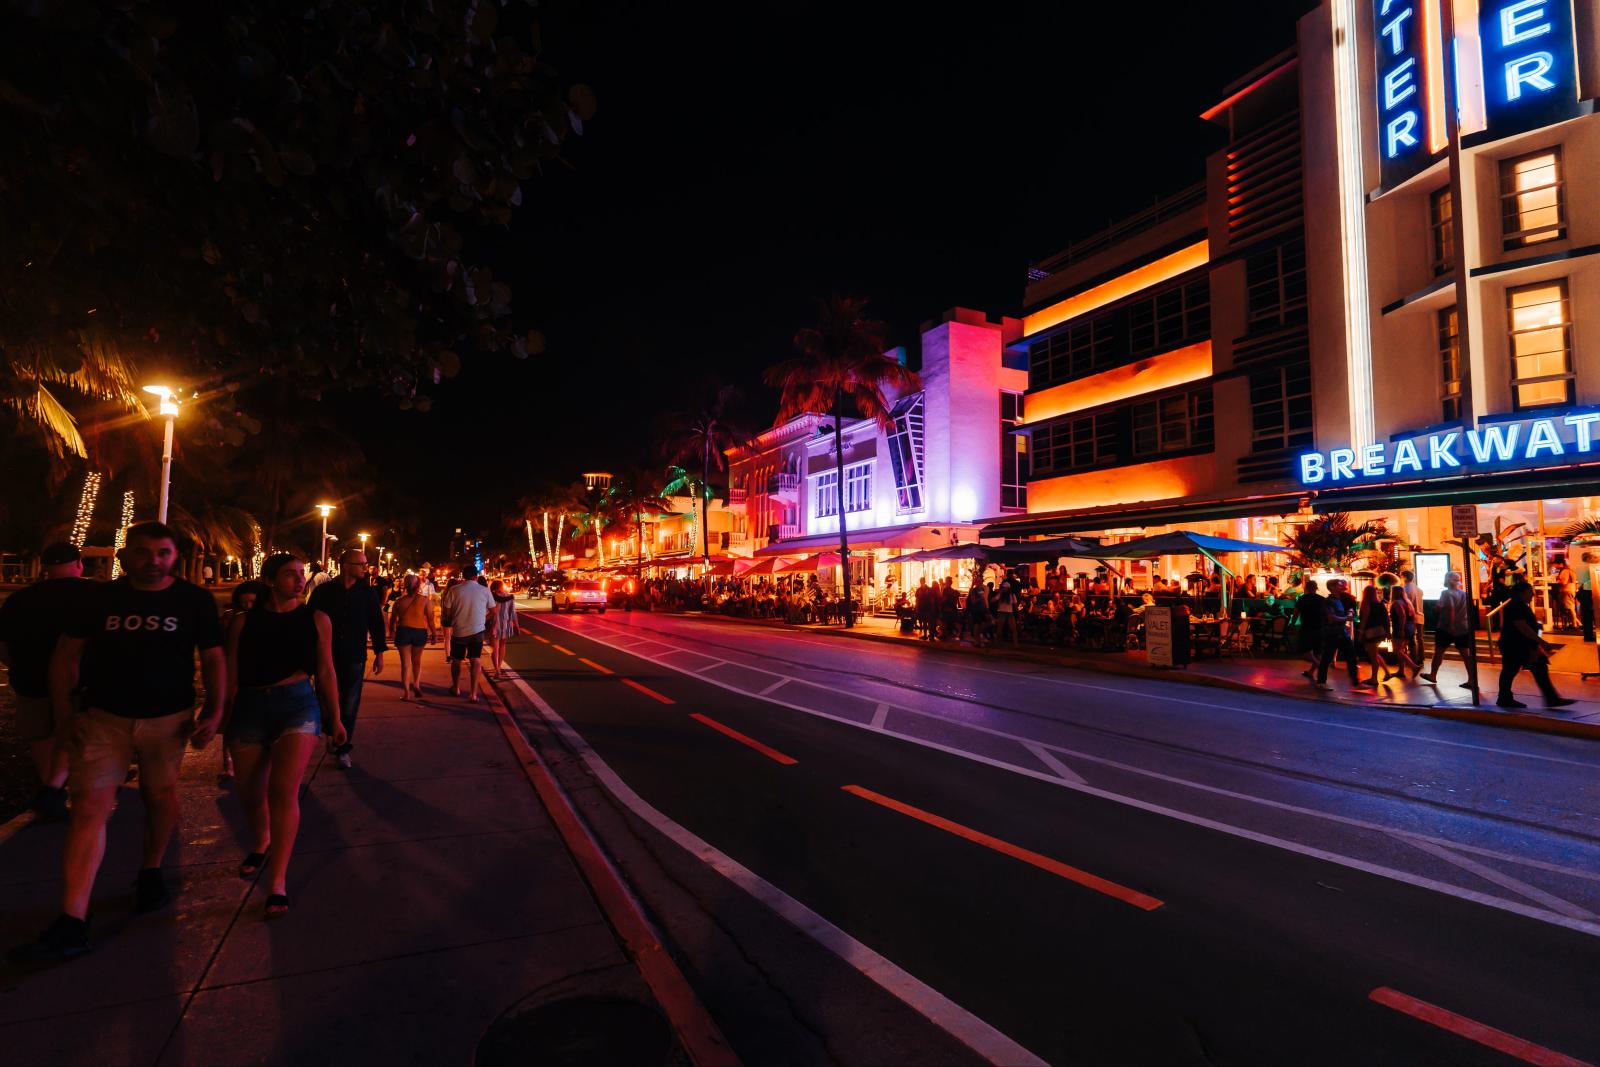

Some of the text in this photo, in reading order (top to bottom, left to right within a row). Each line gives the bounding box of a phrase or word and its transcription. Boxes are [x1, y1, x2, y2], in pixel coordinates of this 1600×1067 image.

[1500, 0, 1558, 102] ER
[1300, 412, 1600, 484] BREAKWAT
[105, 615, 178, 631] BOSS
